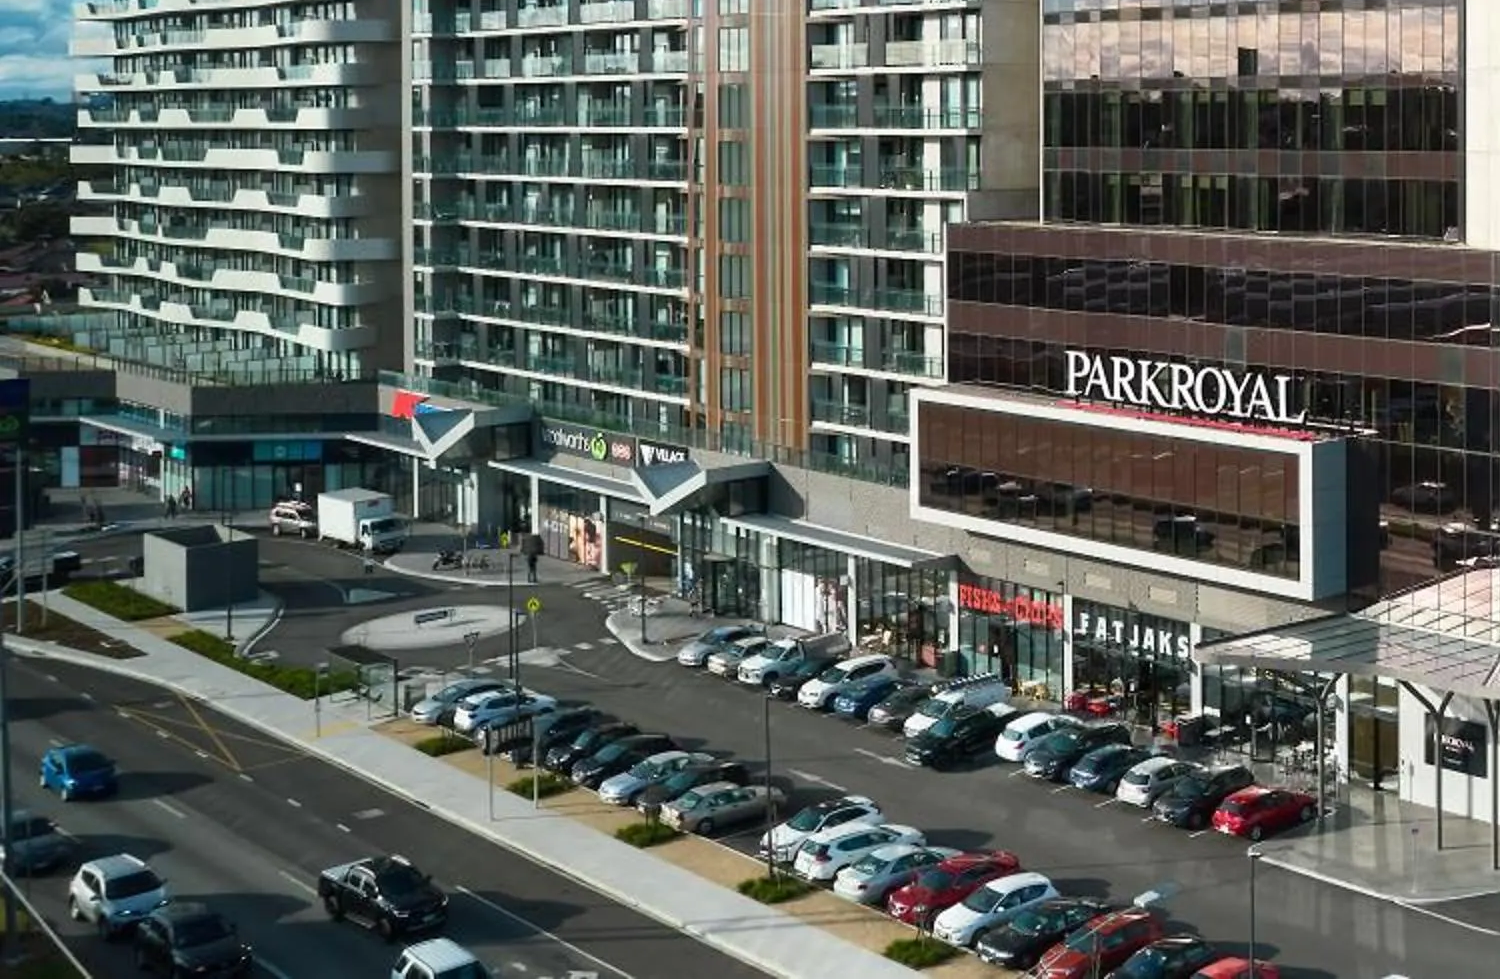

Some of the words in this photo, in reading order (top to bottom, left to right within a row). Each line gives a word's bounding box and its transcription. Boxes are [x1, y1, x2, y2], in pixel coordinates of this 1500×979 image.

[1064, 350, 1308, 424] PARKROYAL
[1079, 612, 1124, 643] FAT
[1129, 625, 1189, 659] JAKS
